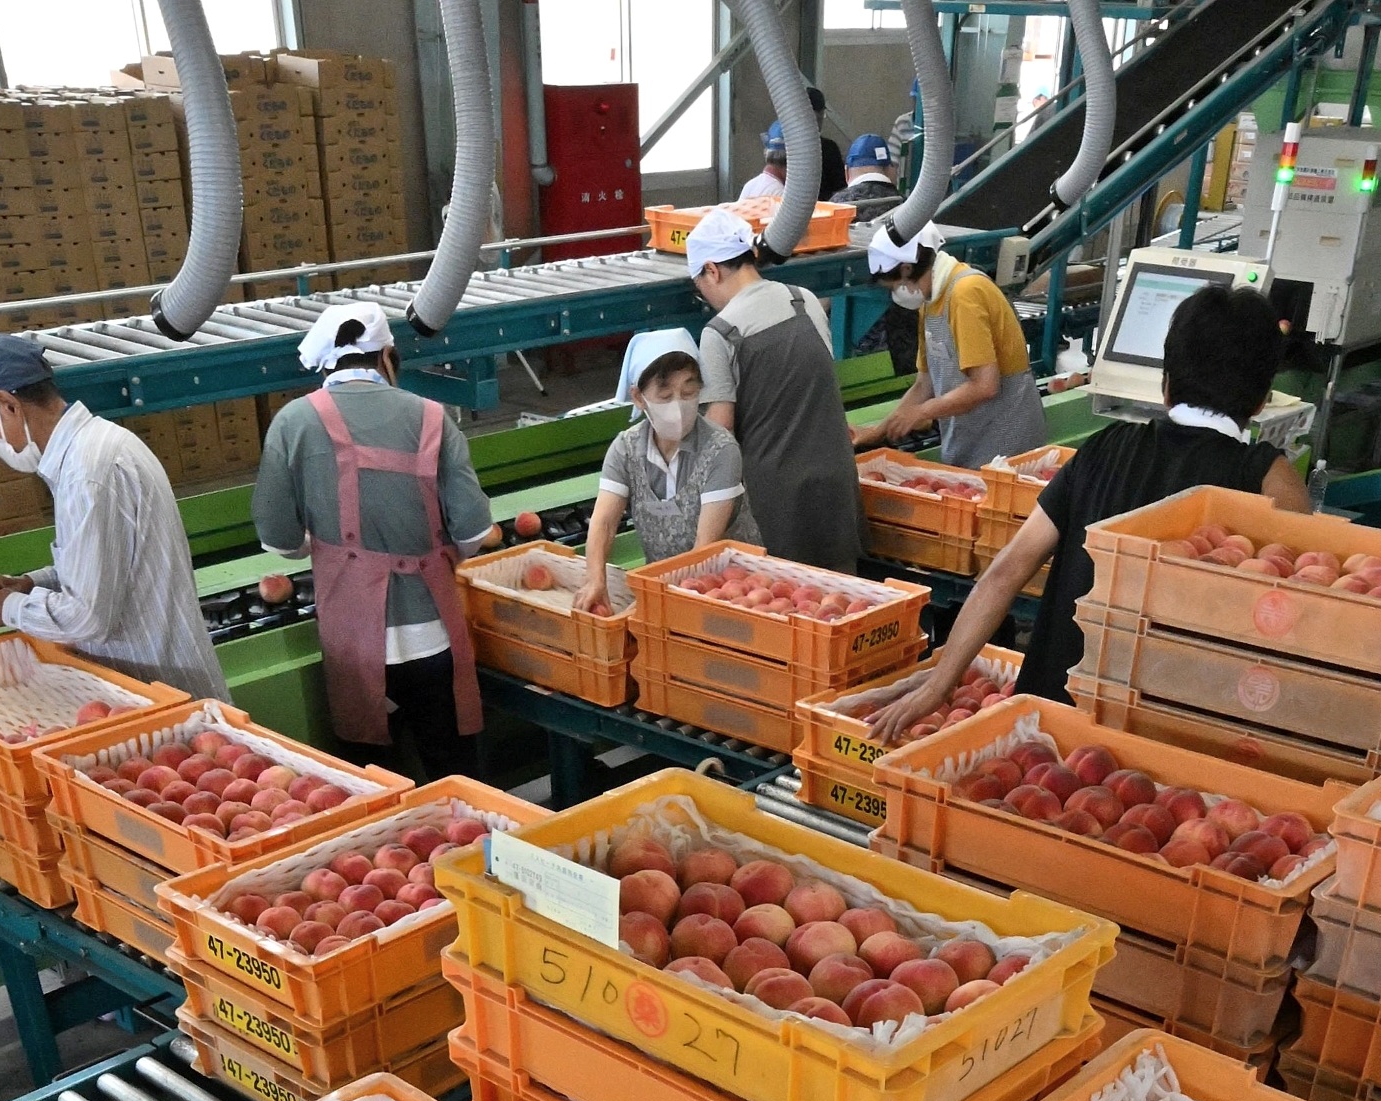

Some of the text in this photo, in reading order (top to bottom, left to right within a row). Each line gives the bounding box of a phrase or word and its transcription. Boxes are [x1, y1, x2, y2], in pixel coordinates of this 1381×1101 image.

[670, 230, 690, 245] 47-
[851, 620, 900, 653] 47-23950
[834, 736, 889, 764] 47-239
[208, 935, 281, 989] 47-23950
[219, 998, 291, 1053] 47-23950
[683, 1013, 739, 1076] 27
[959, 1007, 1038, 1081] 51027
